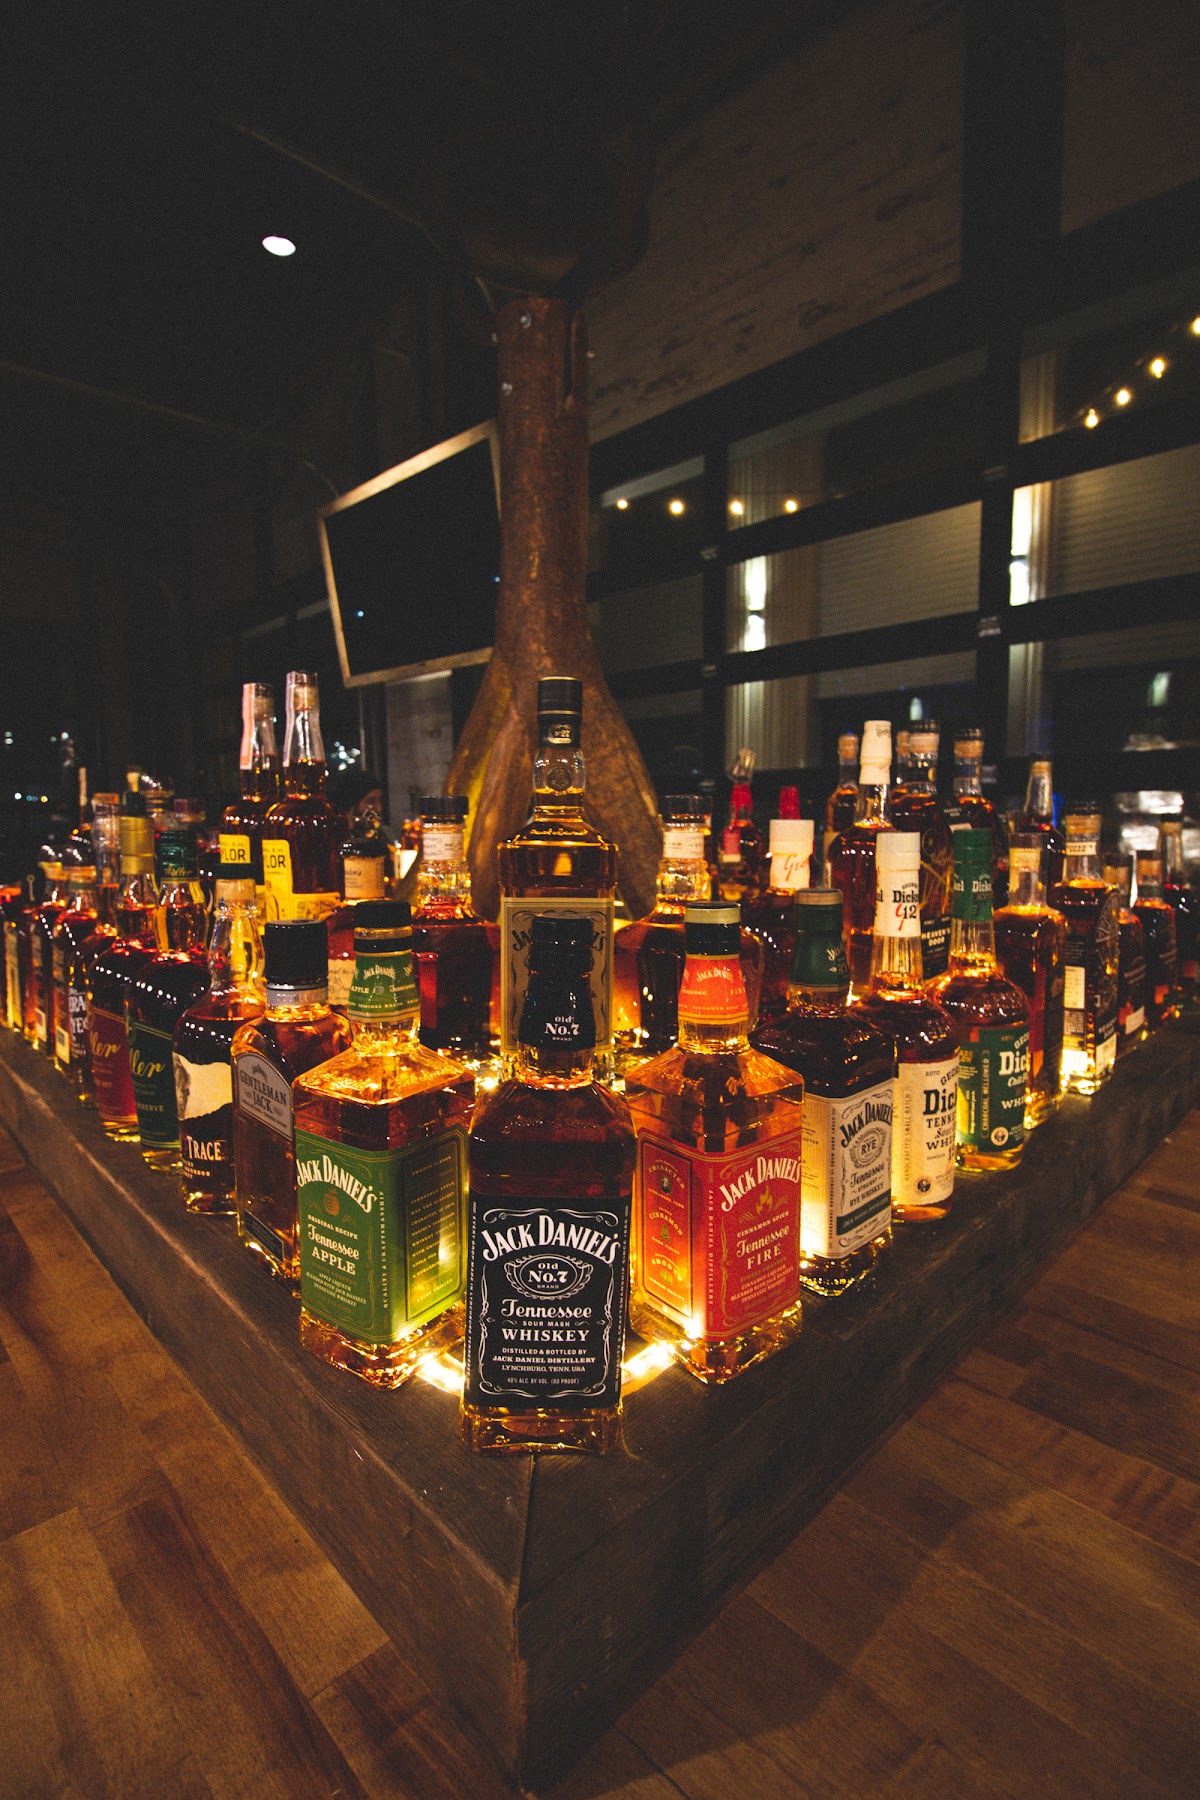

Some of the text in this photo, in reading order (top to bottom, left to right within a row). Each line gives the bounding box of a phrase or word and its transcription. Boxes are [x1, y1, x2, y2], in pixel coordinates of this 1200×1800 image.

[266, 855, 286, 868] LOR
[902, 904, 917, 920] 12
[350, 986, 370, 994] APPLE
[544, 1023, 580, 1036] No.7
[89, 1030, 121, 1058] ller
[128, 1048, 166, 1078] ller
[999, 1051, 1026, 1076] Dic
[240, 1070, 287, 1106] GENTLEMAN
[253, 1090, 274, 1114] JACK
[803, 1137, 819, 1145] ACTER
[839, 1111, 865, 1148] JACK
[186, 1135, 222, 1160] TRACE
[861, 1139, 876, 1155] RYE
[296, 1154, 378, 1214] JACK DANIEL'S
[648, 1164, 685, 1190] CHARACTER
[719, 1156, 801, 1212] JACK DANIEL'S
[850, 1162, 884, 1188] Tennessee
[849, 1183, 884, 1207] RYE WHISKEY
[308, 1214, 358, 1240] ORIGINAL RECIPE
[379, 1191, 387, 1262] CRAFTSMANSHIP
[649, 1211, 683, 1236] CINNAMON
[737, 1211, 789, 1238] CINNAMON SPICE
[308, 1223, 360, 1260] Tennessee
[481, 1222, 536, 1262] JACK
[538, 1214, 621, 1265] DANIEL'S
[736, 1225, 790, 1258] Tennessee
[312, 1246, 356, 1276] APPLE
[538, 1262, 558, 1270] Old
[747, 1243, 781, 1270] FIRE
[528, 1270, 568, 1284] No.7
[501, 1299, 592, 1319] Tennessee
[617, 1266, 625, 1335] CRAFTSMANSHIP
[502, 1328, 590, 1342] WHISKEY
